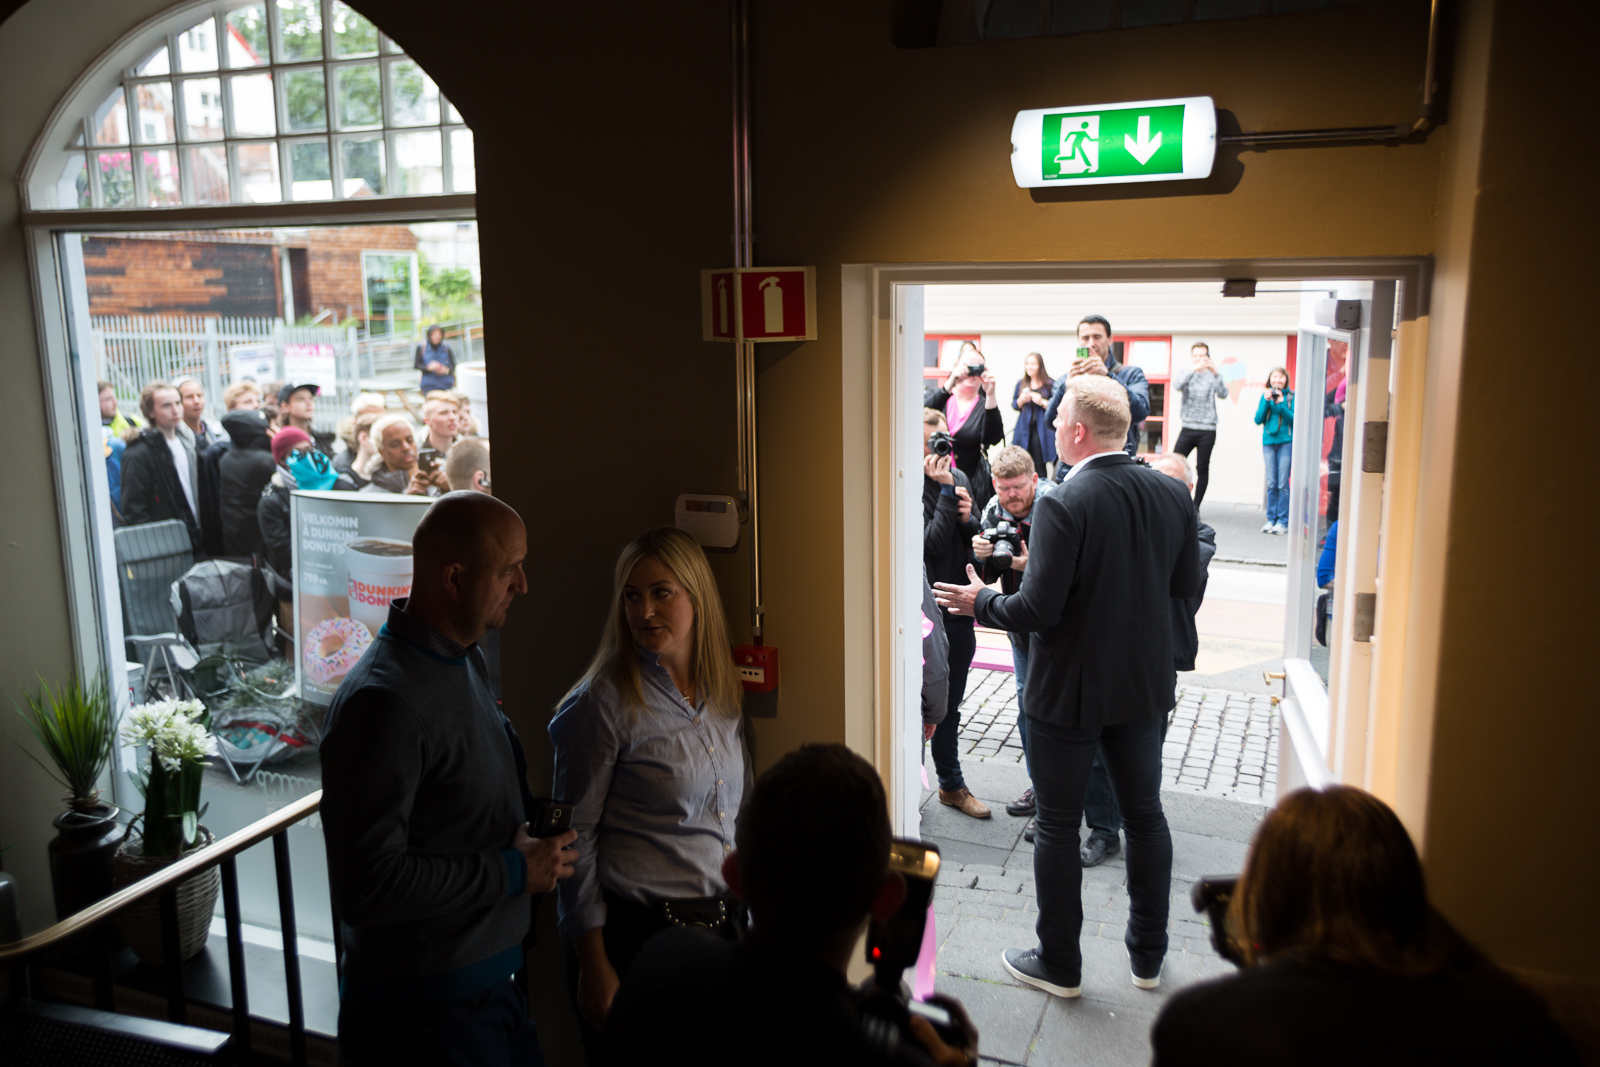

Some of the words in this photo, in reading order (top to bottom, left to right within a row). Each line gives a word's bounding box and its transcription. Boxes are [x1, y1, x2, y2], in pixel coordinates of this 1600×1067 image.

[302, 512, 358, 528] VELKOMIN
[311, 527, 358, 540] DUNKIN'
[303, 538, 346, 554] DONUTS
